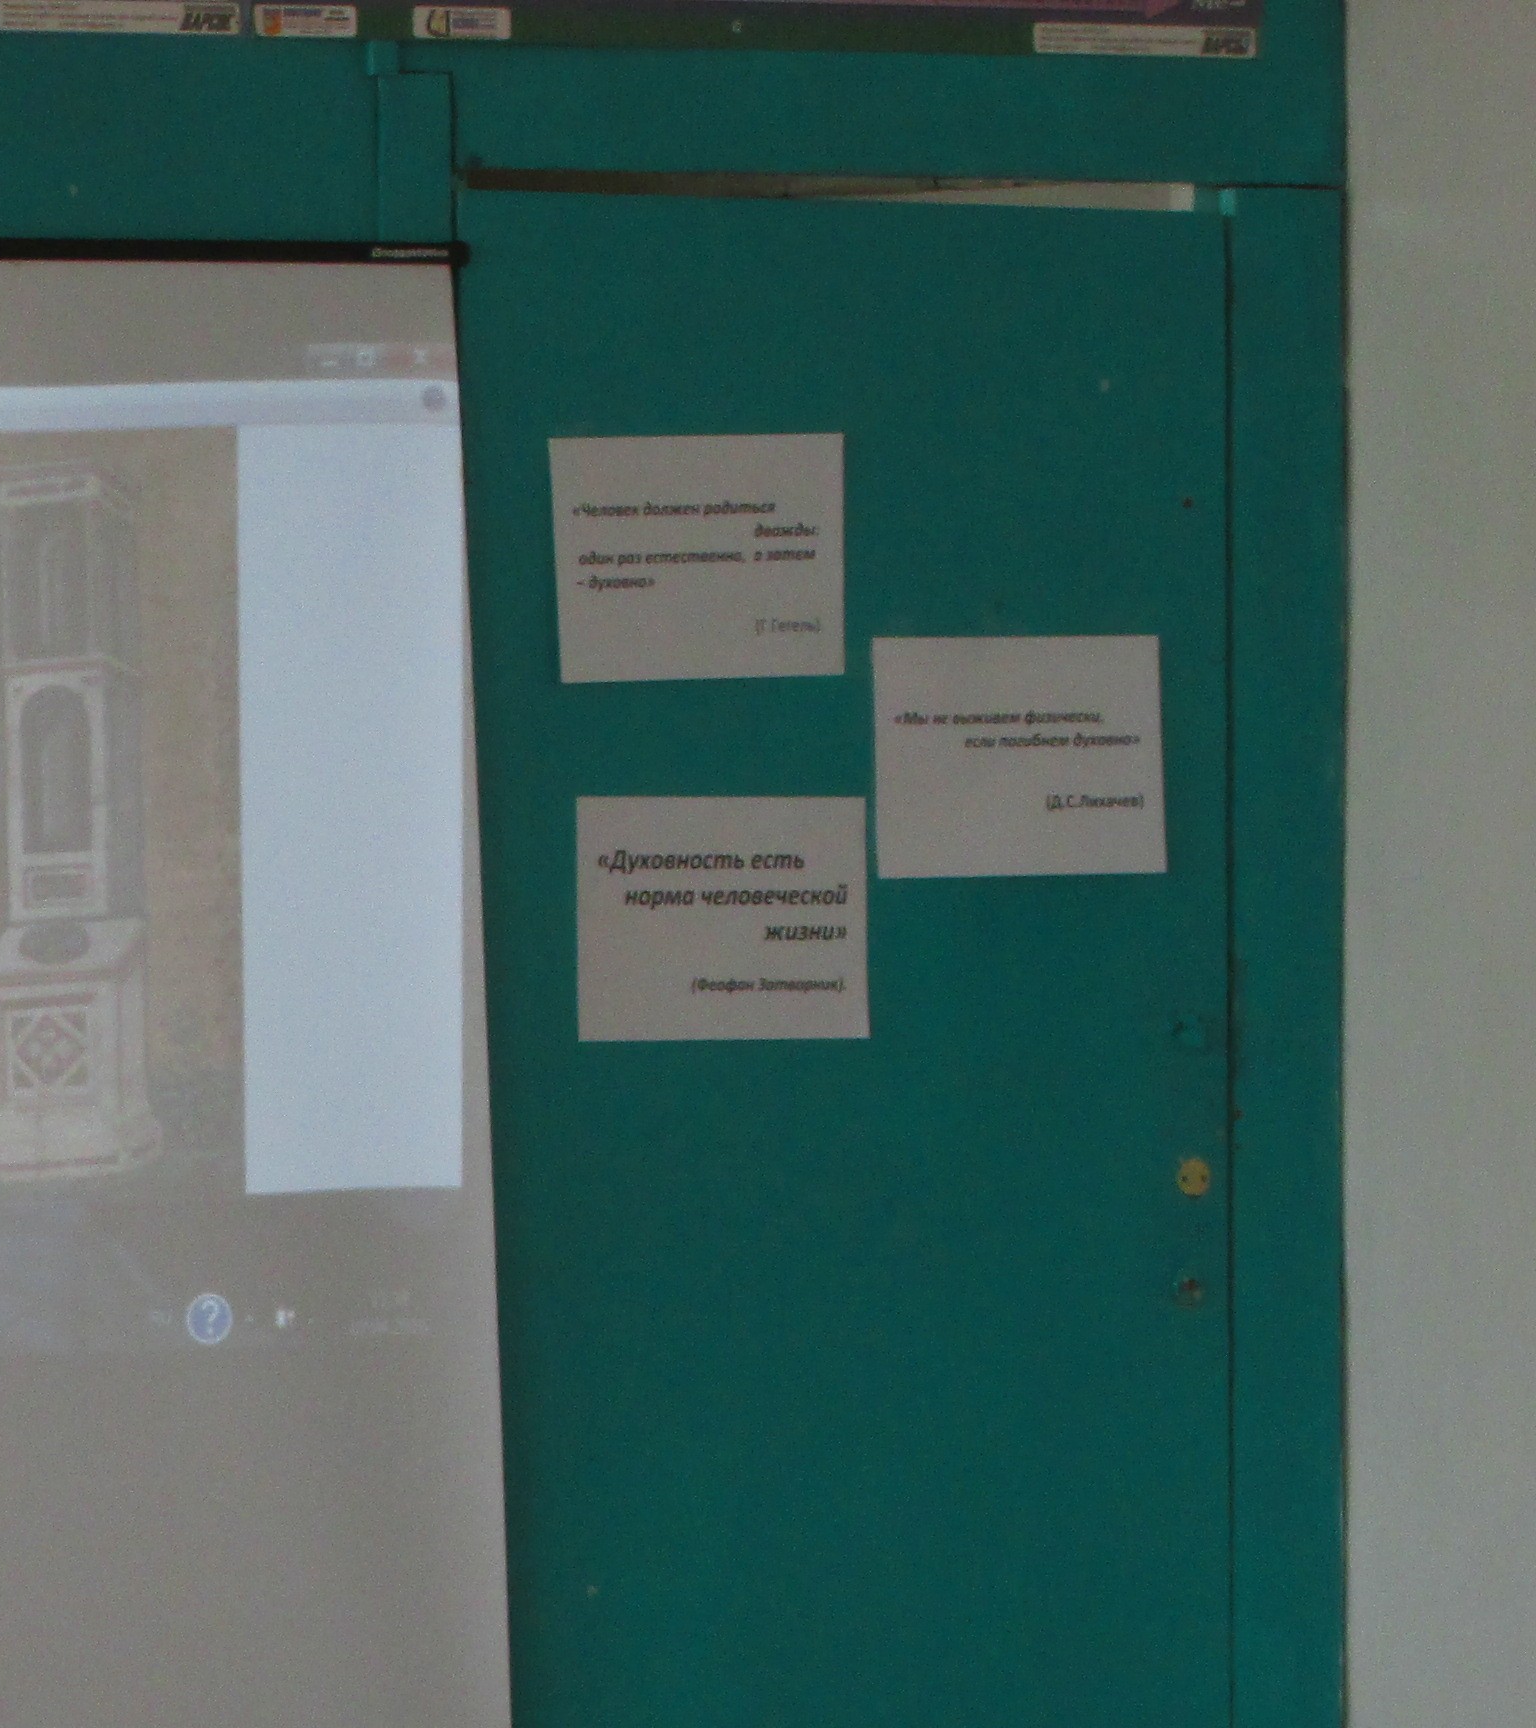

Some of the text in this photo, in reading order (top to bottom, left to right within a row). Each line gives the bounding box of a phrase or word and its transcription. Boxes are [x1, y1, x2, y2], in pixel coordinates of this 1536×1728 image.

[597, 849, 805, 874] «Духовность есть
[624, 883, 848, 910] норма человеческой
[763, 924, 847, 941] жизни»
